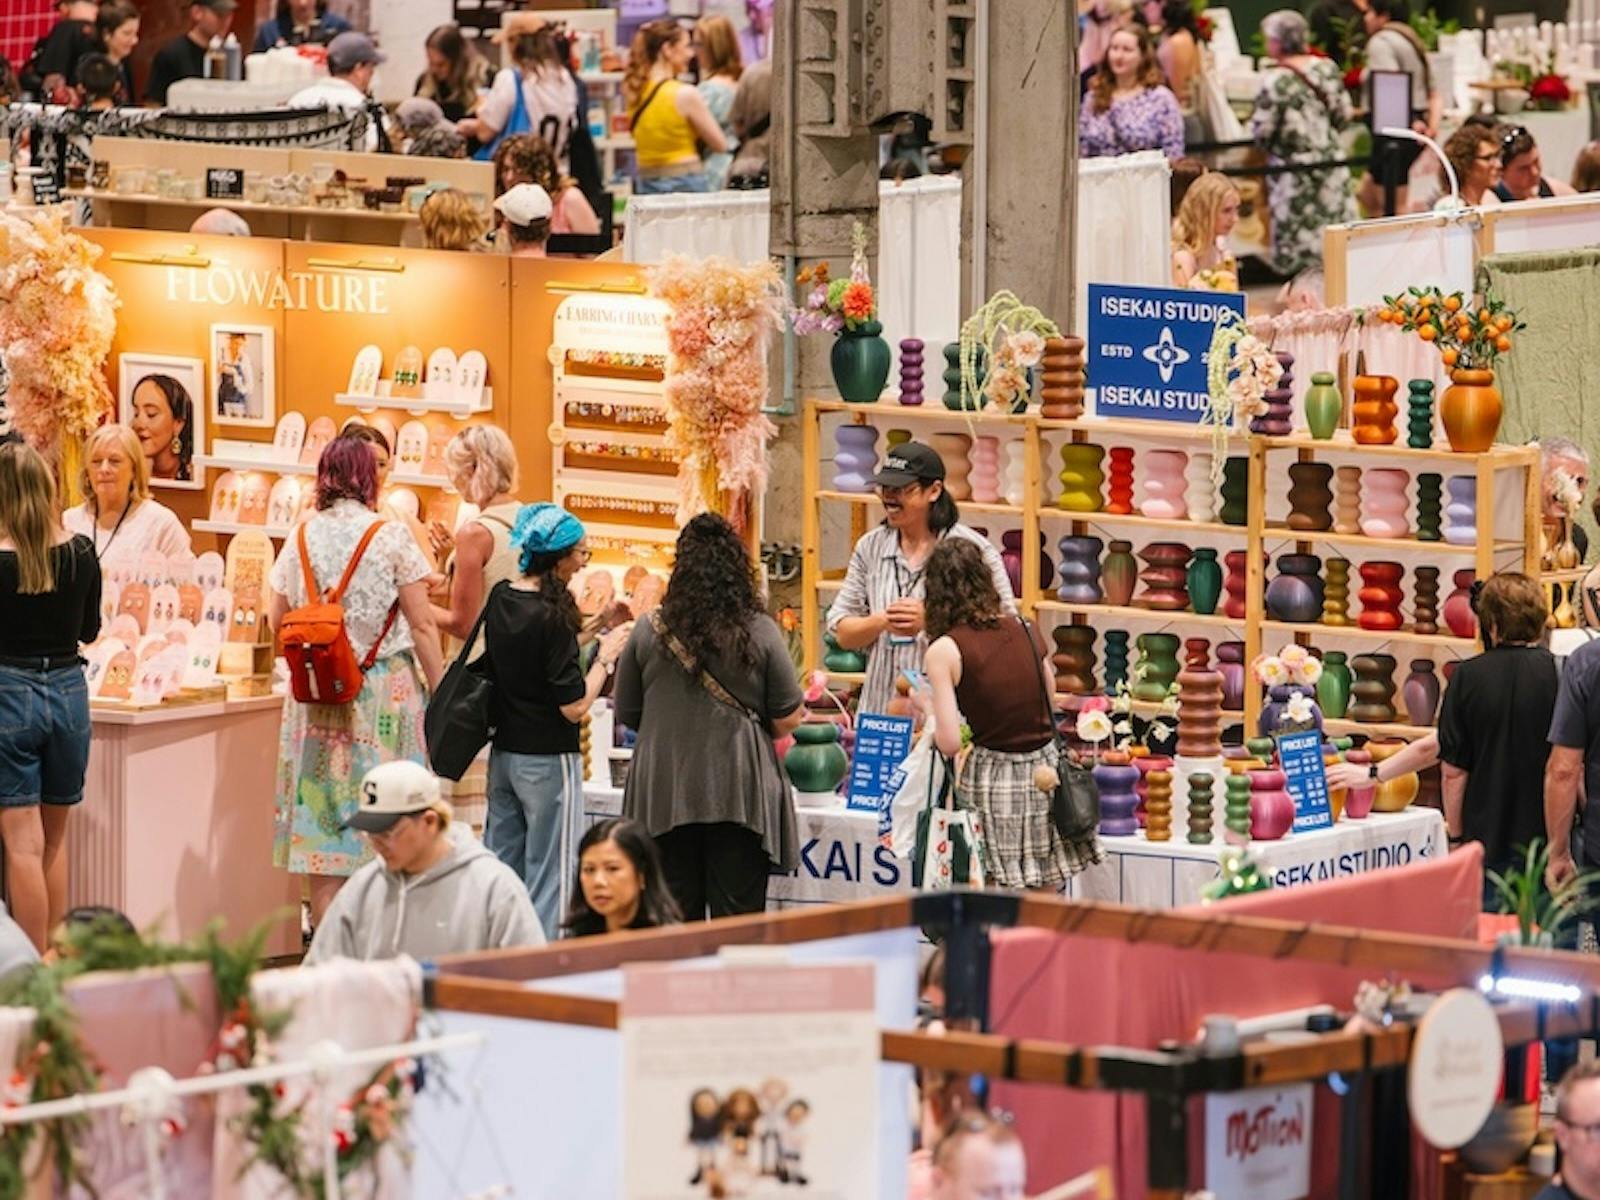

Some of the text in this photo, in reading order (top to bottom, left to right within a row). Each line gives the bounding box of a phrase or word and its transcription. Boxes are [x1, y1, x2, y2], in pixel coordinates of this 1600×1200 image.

[1101, 297, 1162, 319] ISEKAI
[1101, 344, 1134, 359] ESTD
[1101, 386, 1211, 411] ISEKAI STUD
[861, 718, 910, 734] PRICE LIST
[1281, 736, 1318, 752] PRICE LIST
[851, 794, 880, 808] PRICE
[1293, 812, 1330, 828] PRICE LIST
[769, 838, 900, 886] KAI S
[1339, 842, 1411, 874] STUDIO
